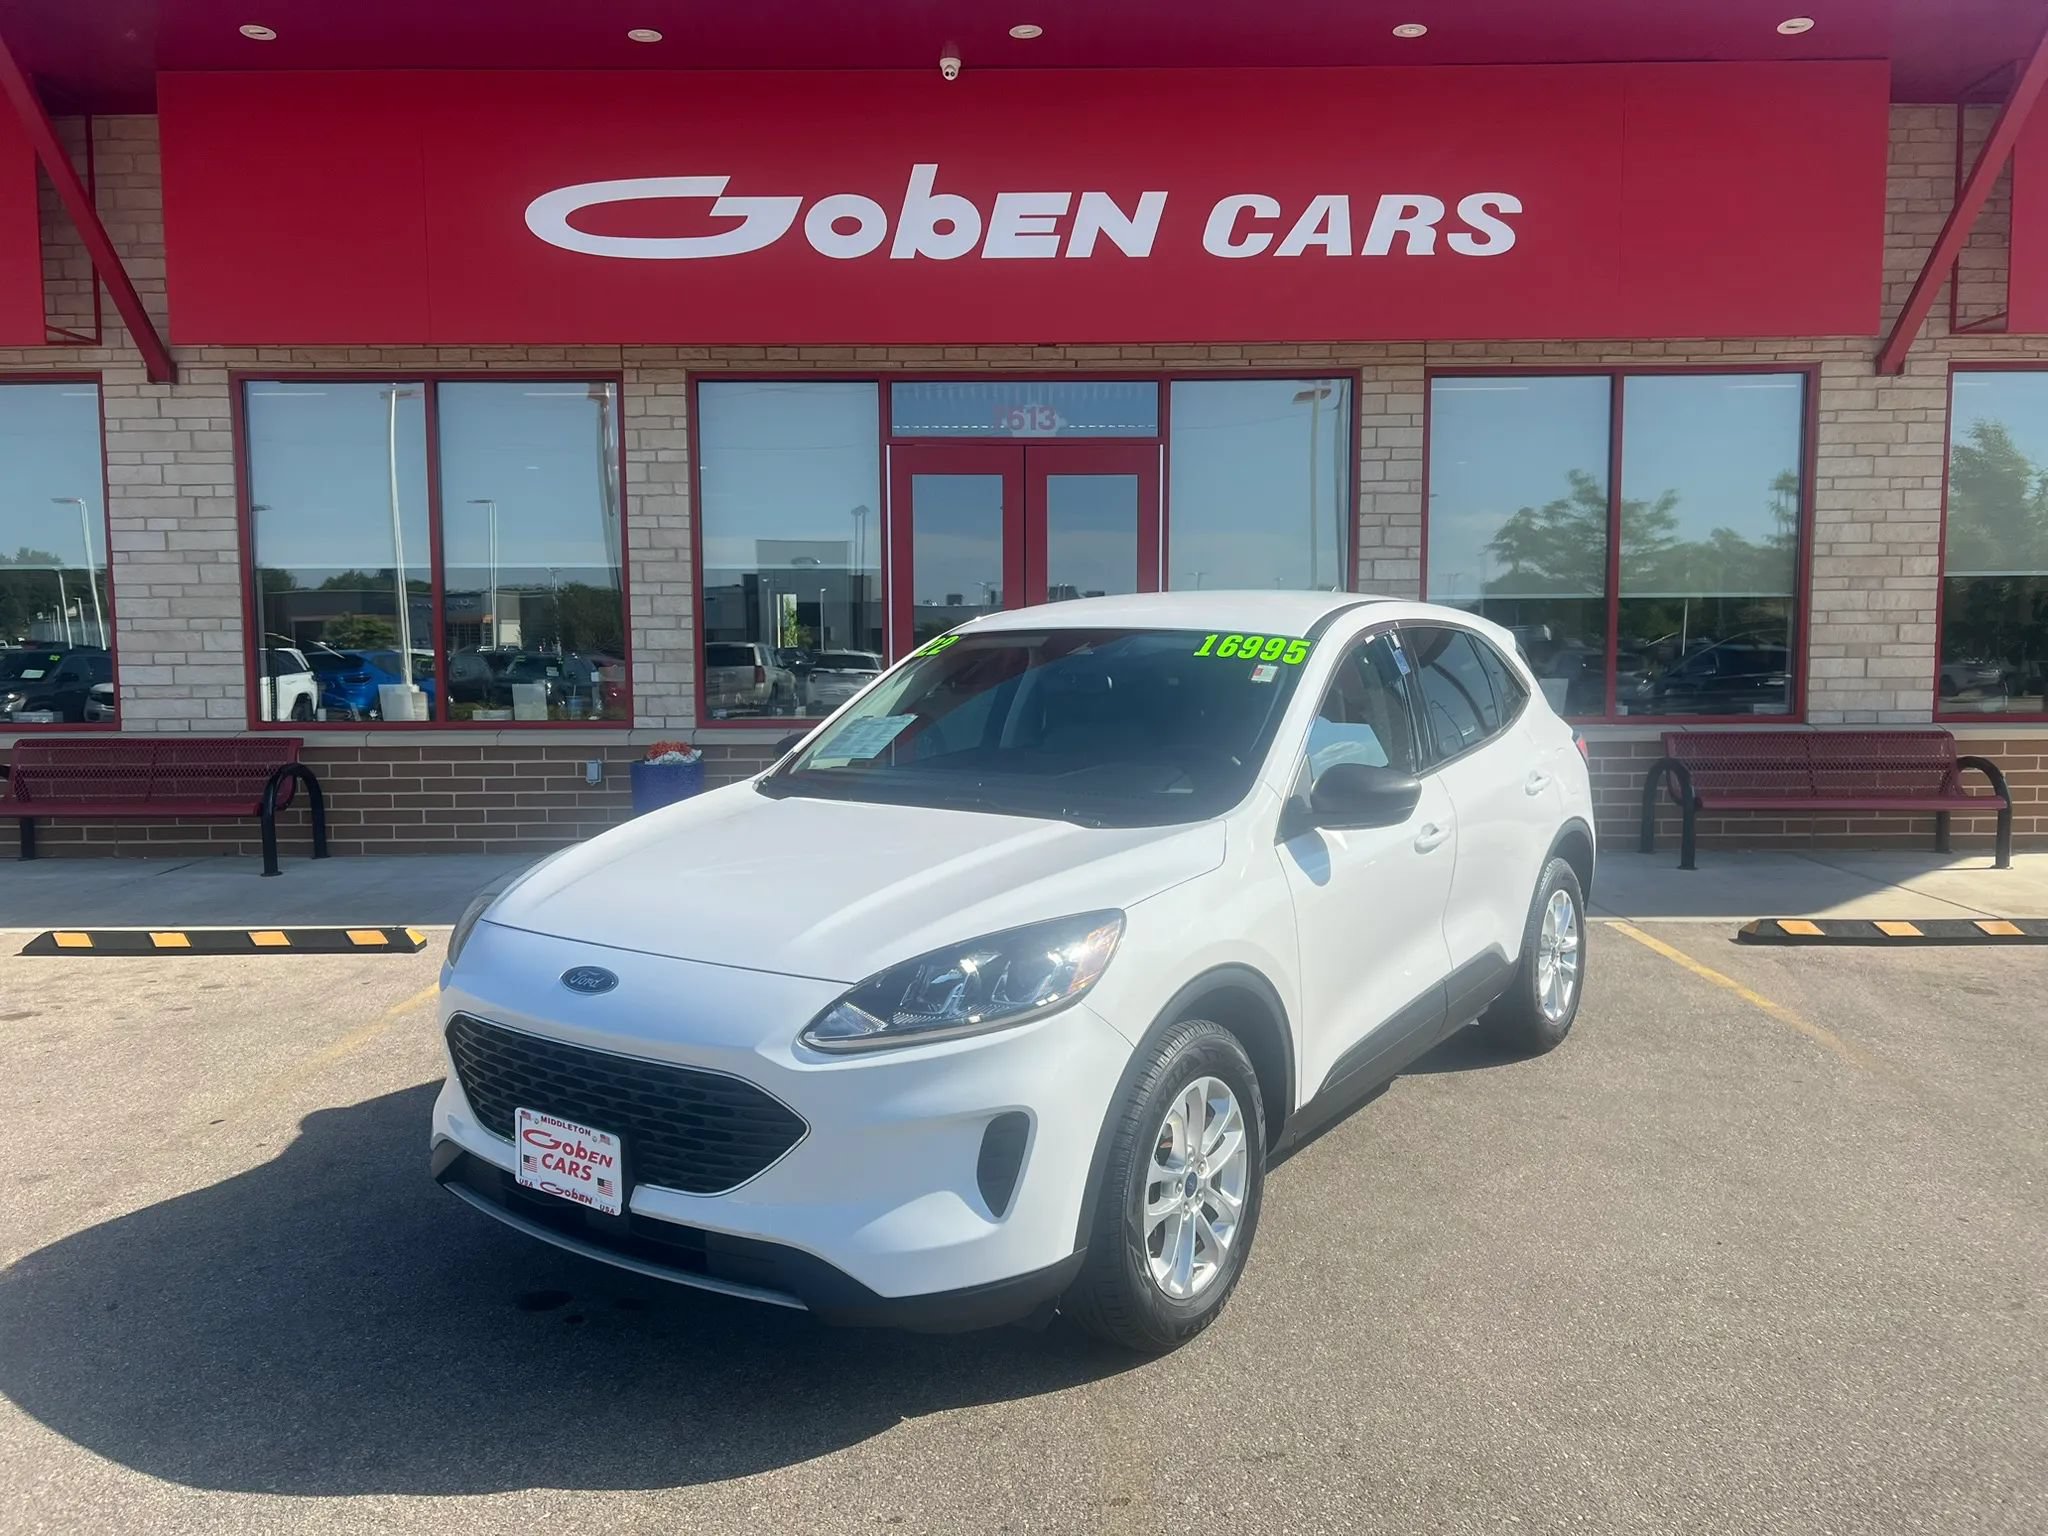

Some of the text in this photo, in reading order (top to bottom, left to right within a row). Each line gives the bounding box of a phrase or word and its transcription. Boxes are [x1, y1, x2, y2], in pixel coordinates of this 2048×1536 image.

[1202, 192, 1523, 258] CARS
[1192, 633, 1312, 665] 16995
[569, 969, 606, 988] Ford
[540, 1115, 592, 1137] MIDDLETON
[541, 1153, 592, 1181] CARS
[519, 1178, 534, 1188] USA
[600, 1204, 615, 1215] USA
